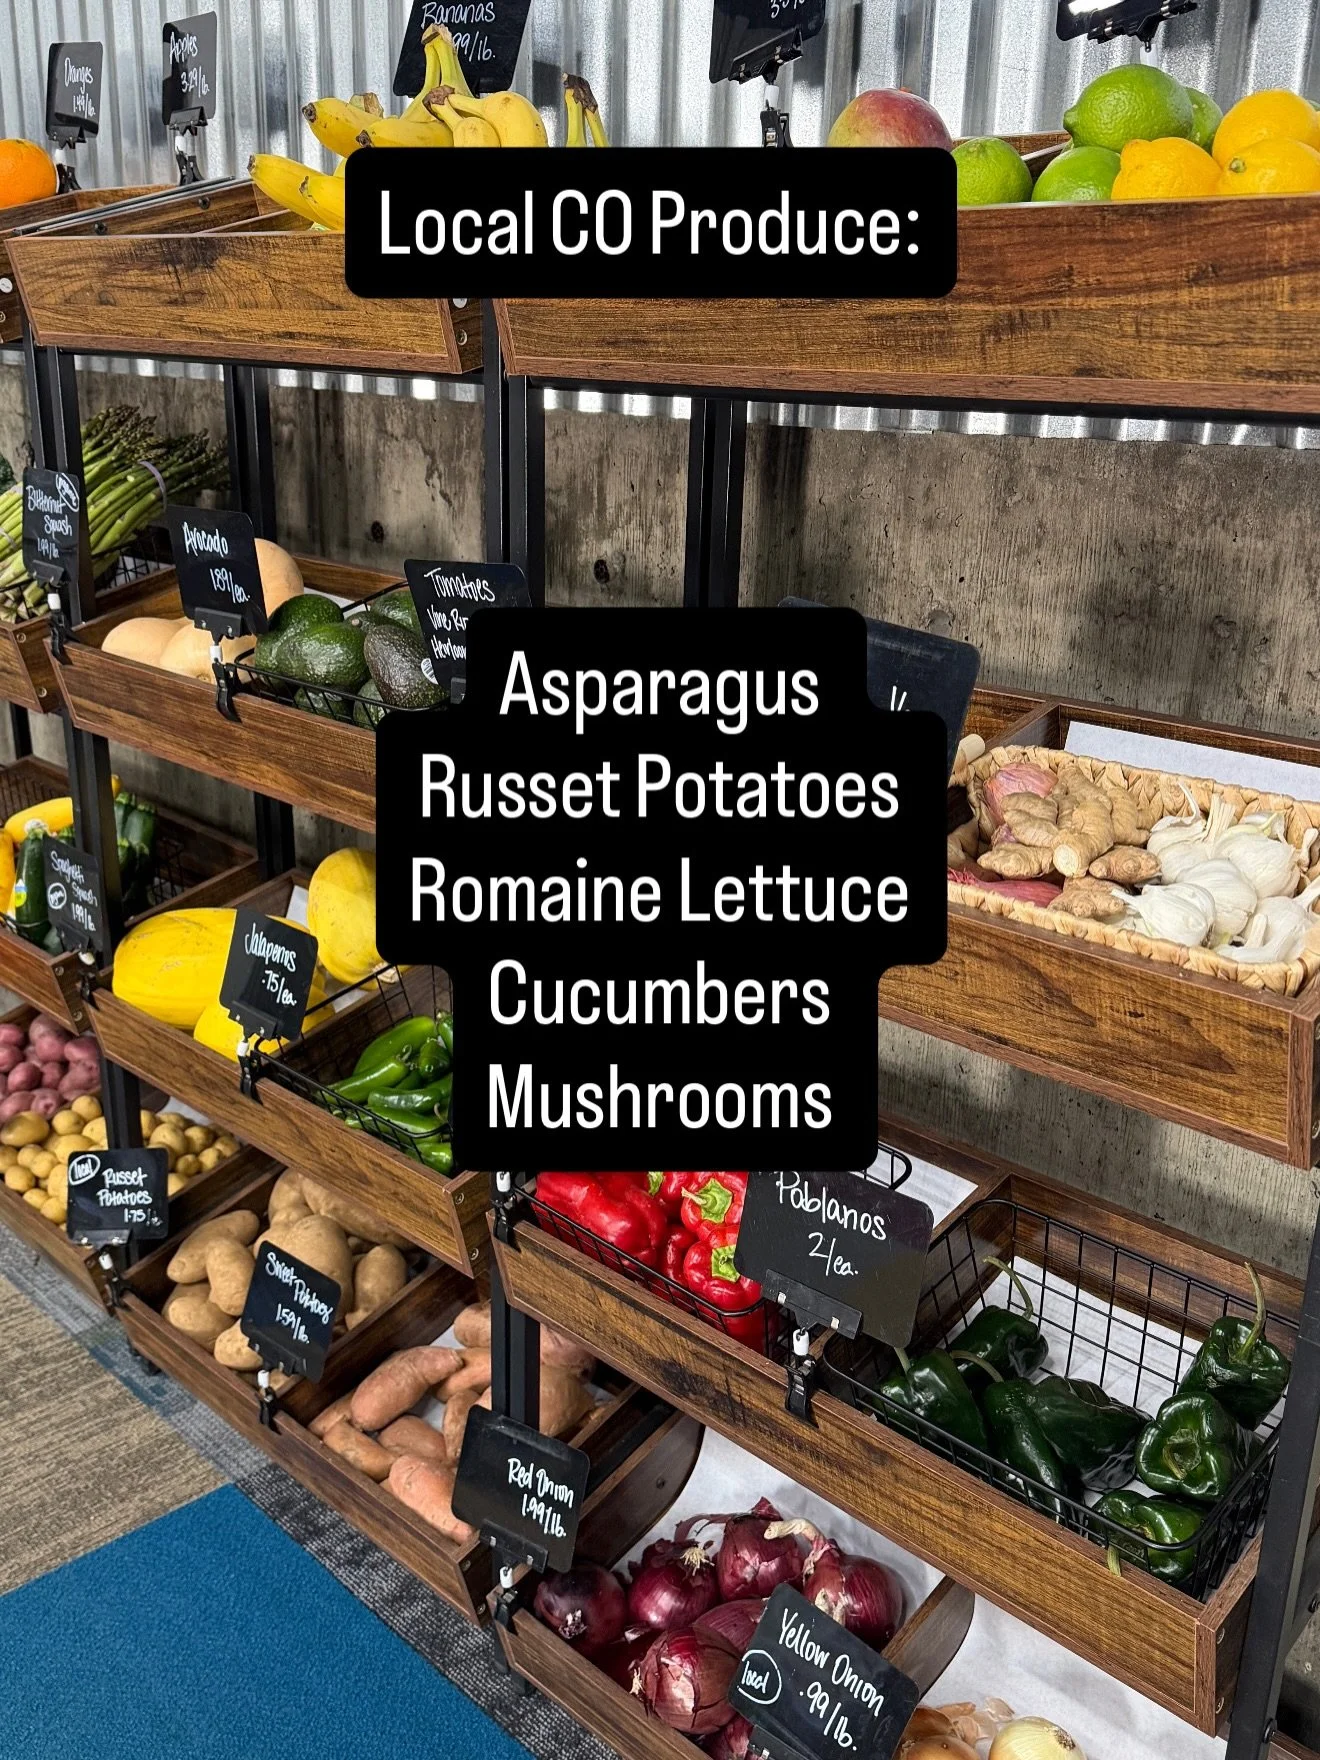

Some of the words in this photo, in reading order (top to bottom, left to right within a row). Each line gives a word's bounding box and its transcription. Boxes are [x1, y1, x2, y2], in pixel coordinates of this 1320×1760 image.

[421, 1, 496, 29] Bananas
[169, 31, 199, 65] Apples
[64, 57, 94, 94] Oranges
[44, 514, 73, 540] Squash
[182, 521, 229, 558] Avocado
[423, 567, 496, 602] Tomatoes
[427, 604, 452, 632] Vine
[102, 1167, 148, 1189] Russet
[96, 1189, 152, 1207] Potatoes
[808, 1231, 859, 1276] 2/ea.
[265, 1252, 297, 1287] Sweet
[293, 1279, 334, 1325] Potatoes
[507, 1457, 534, 1490] Red
[535, 1468, 575, 1509] Onion
[778, 1607, 830, 1669] Yellow
[831, 1654, 885, 1718] Onion
[799, 1681, 858, 1751] .99/lb.
